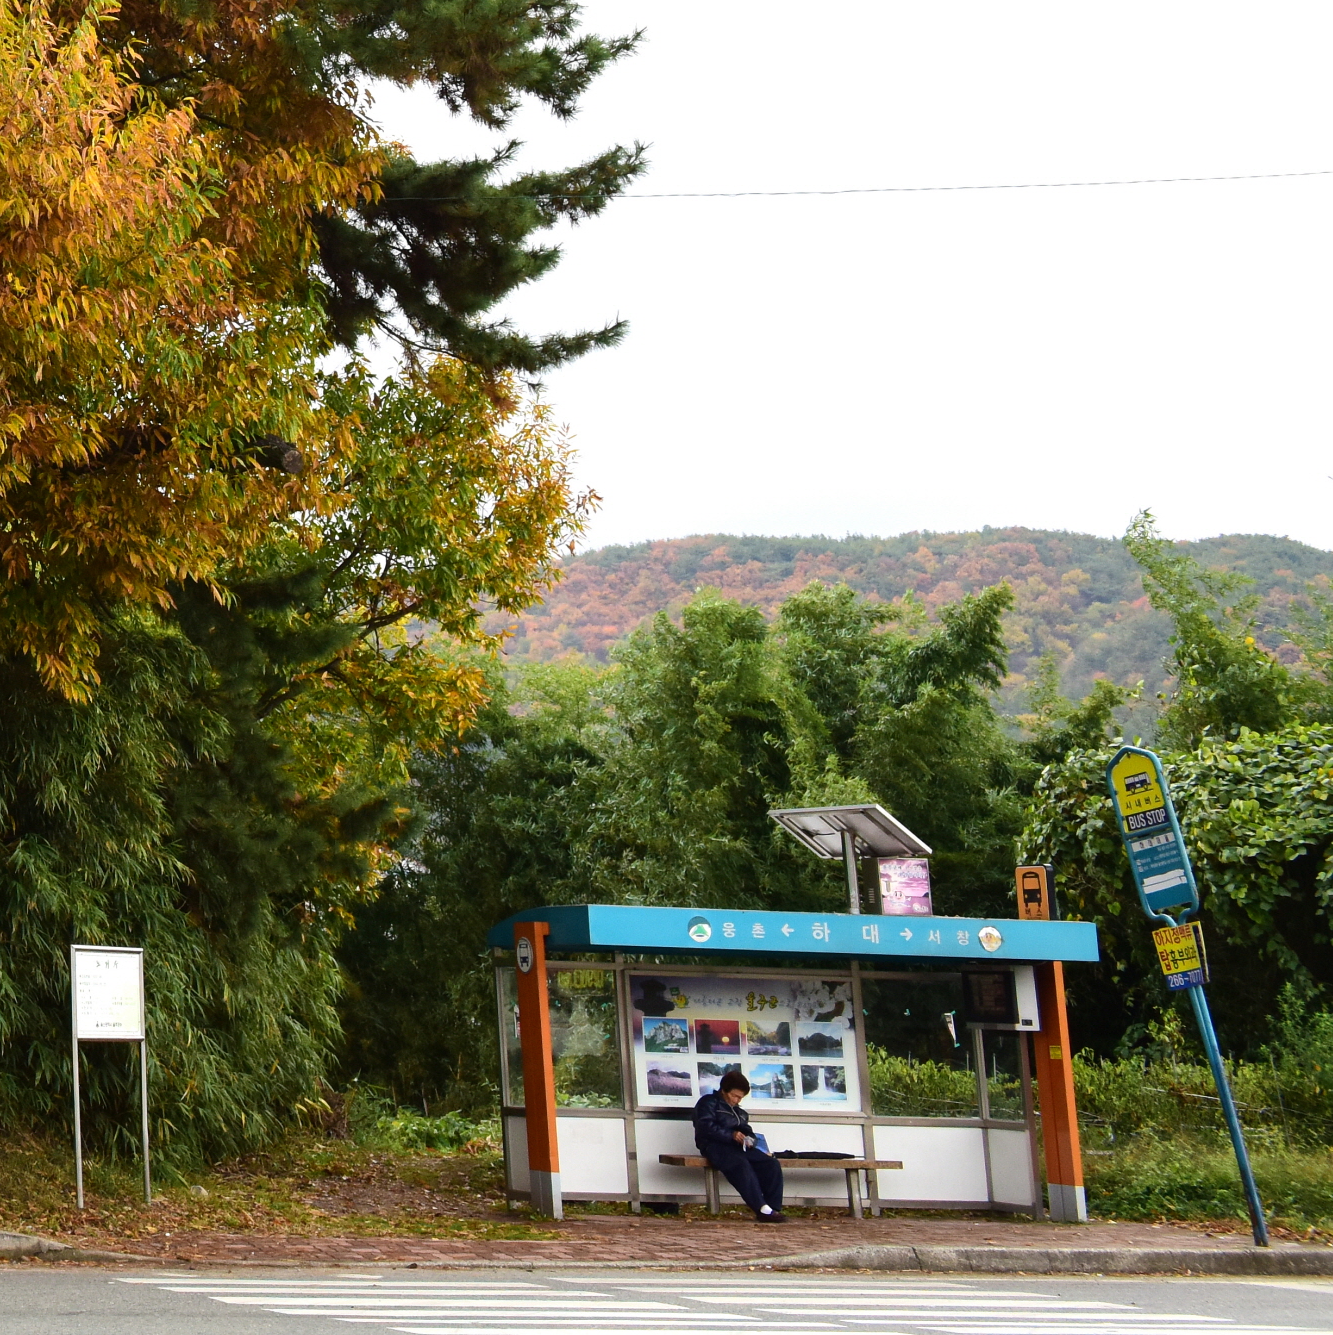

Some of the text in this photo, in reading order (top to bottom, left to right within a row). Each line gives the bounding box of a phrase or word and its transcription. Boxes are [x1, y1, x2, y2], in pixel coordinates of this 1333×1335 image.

[1125, 794, 1161, 811] 시내버스
[1128, 808, 1166, 830] BUS STOP
[811, 921, 881, 945] 하대
